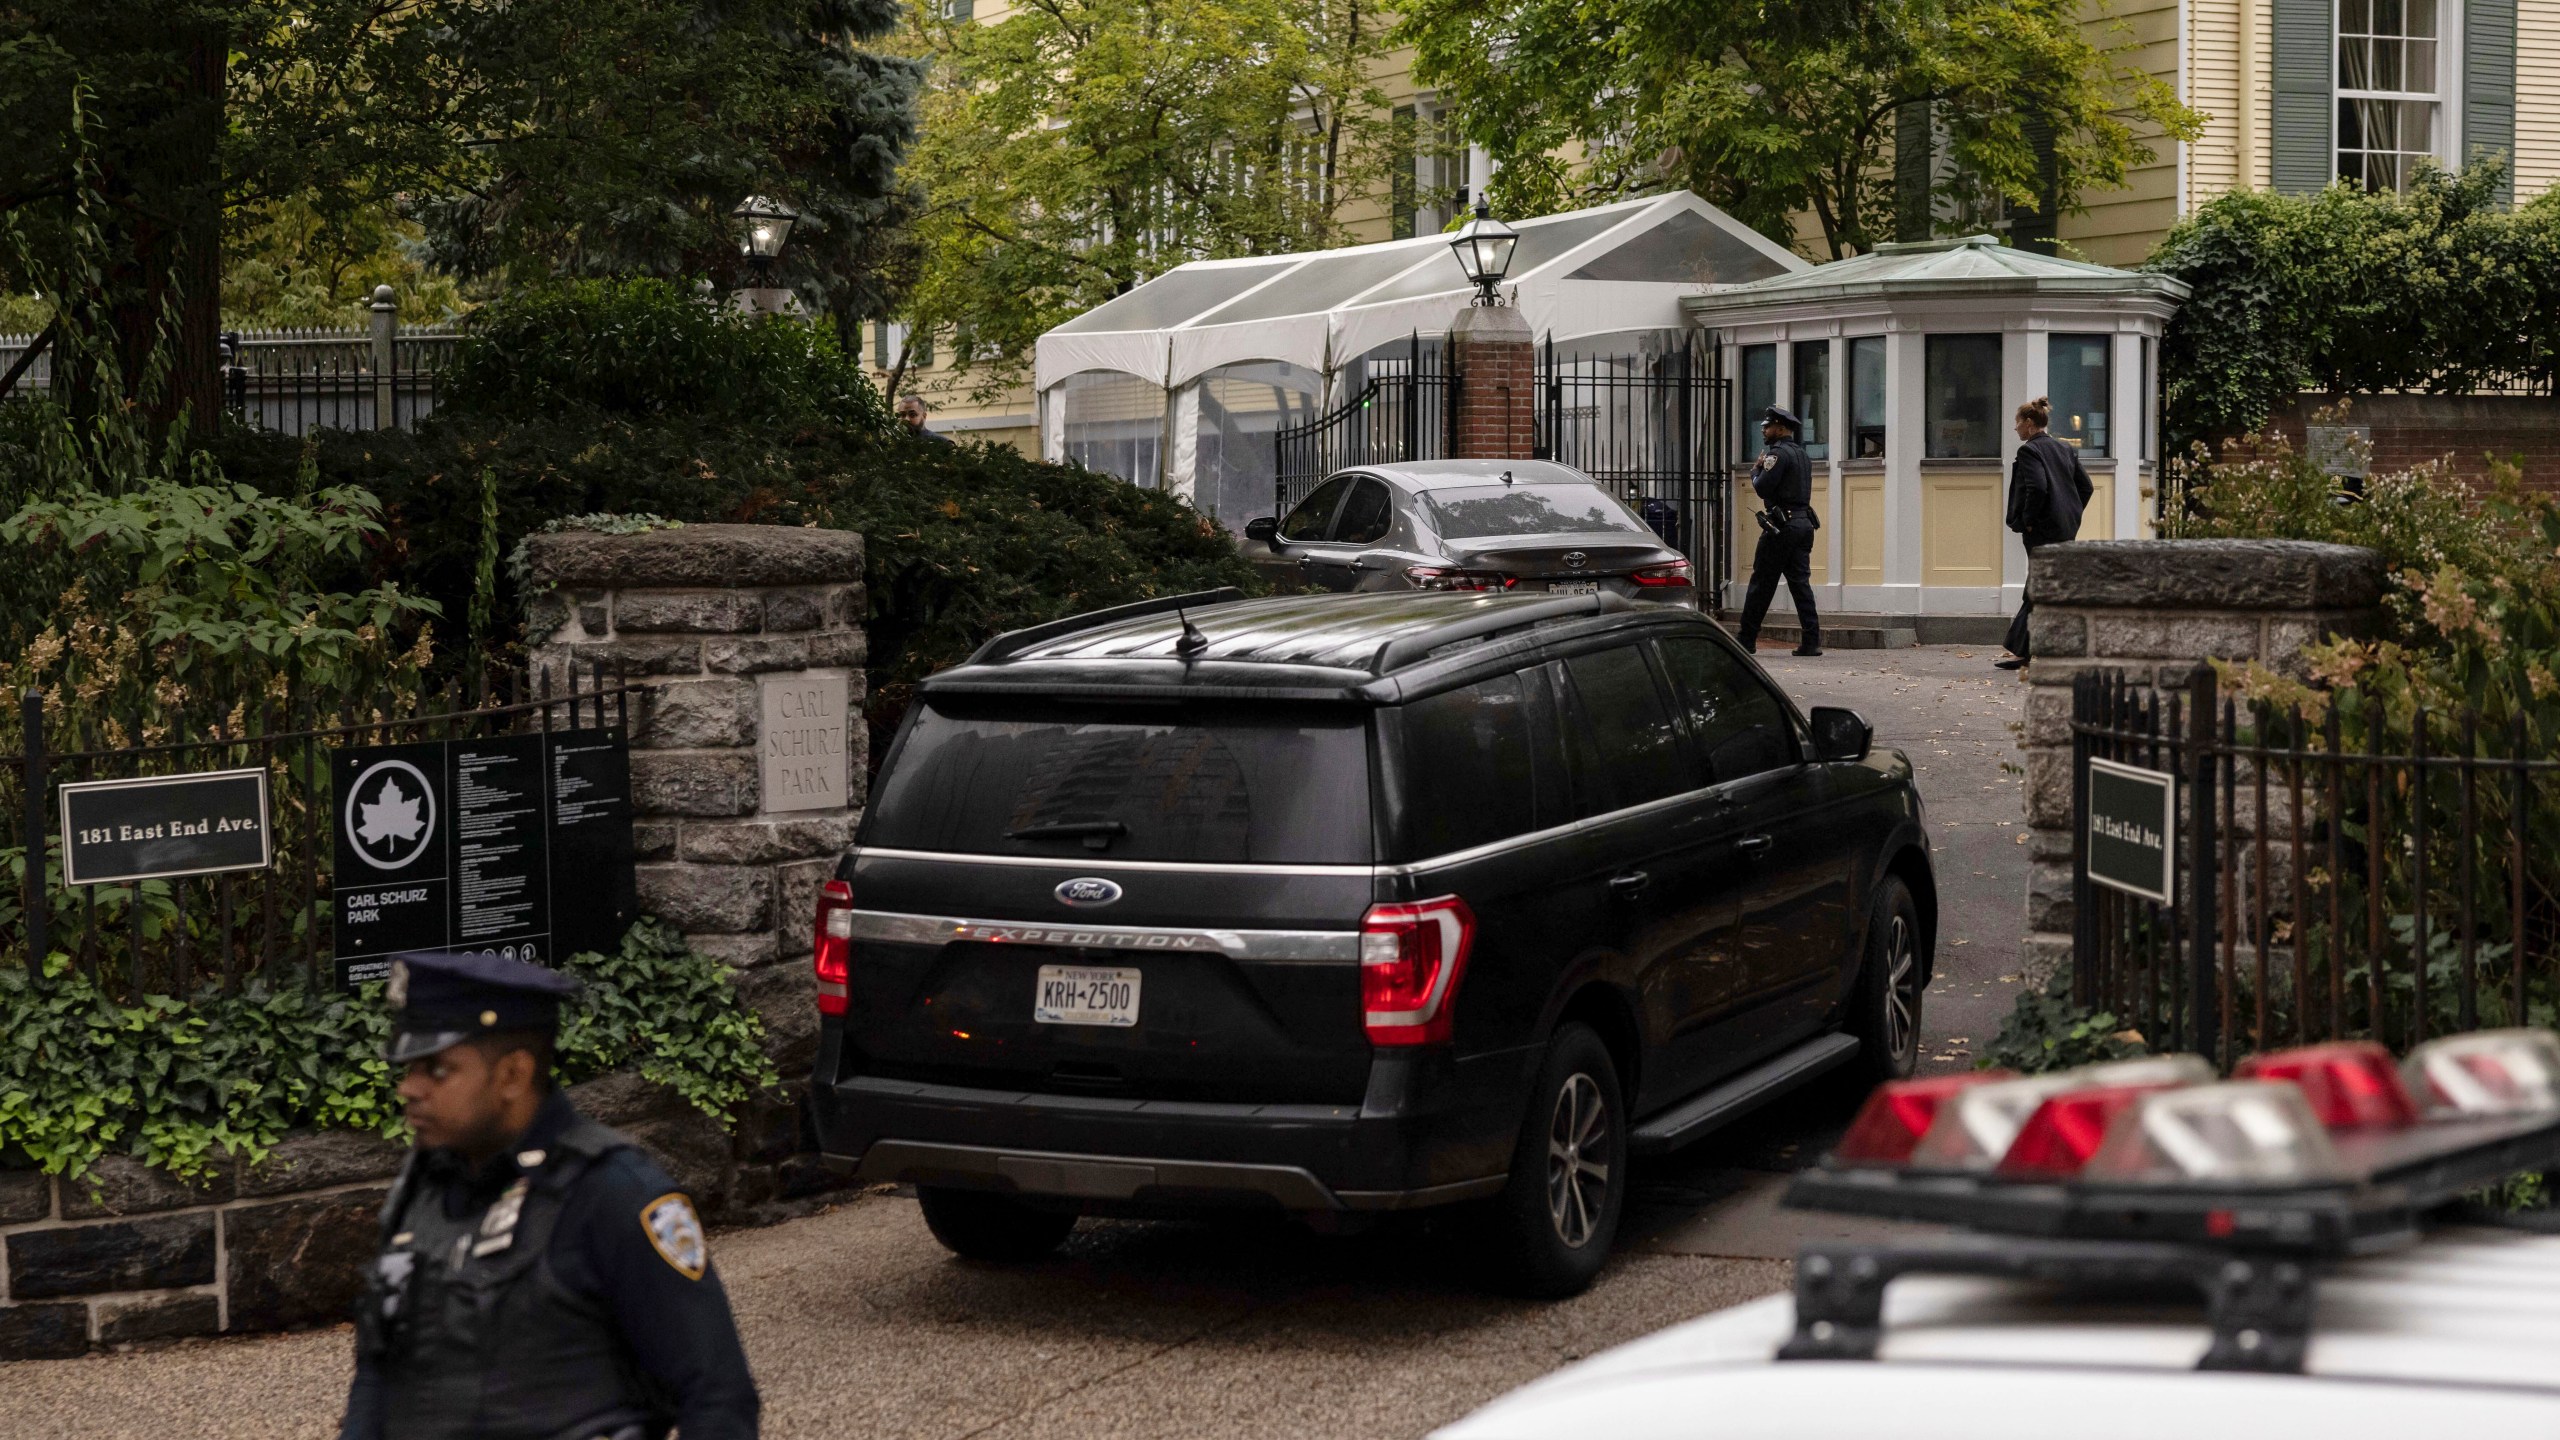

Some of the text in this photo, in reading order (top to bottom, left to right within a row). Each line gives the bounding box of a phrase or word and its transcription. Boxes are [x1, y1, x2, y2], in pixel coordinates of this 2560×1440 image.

[781, 690, 830, 718] CARL
[769, 727, 841, 758] SCHURZ
[781, 766, 830, 796] PARK
[79, 816, 259, 845] 181 East End Ave.
[2105, 816, 2122, 839] East
[2123, 821, 2141, 844] End
[2142, 827, 2163, 850] Ave.
[347, 888, 428, 908] CARL SCHURZ
[1068, 882, 1105, 900] Ford
[347, 908, 380, 924] PARK
[972, 926, 1198, 948] EXPEDITION
[348, 962, 383, 973] OPERATING
[1065, 970, 1115, 981] NEW YORK
[1044, 981, 1131, 1010] KRH 2500
